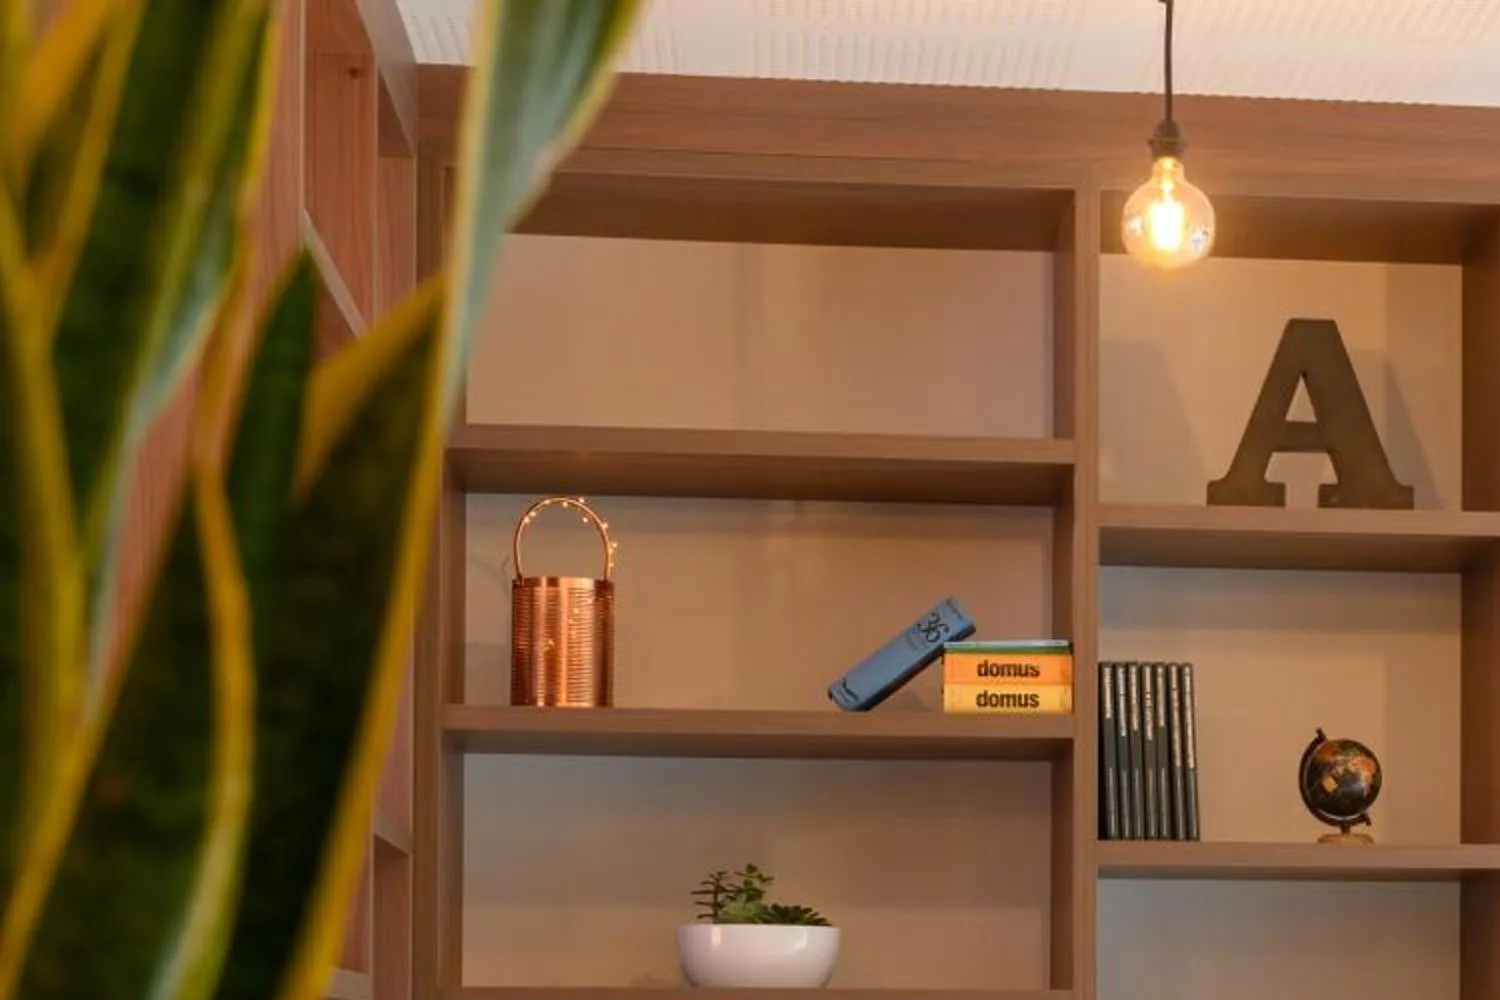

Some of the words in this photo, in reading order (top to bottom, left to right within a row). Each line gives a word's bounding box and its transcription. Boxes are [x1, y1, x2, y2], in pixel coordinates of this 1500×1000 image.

[1207, 318, 1414, 510] A
[977, 660, 1041, 678] domus
[976, 690, 1040, 709] domus
